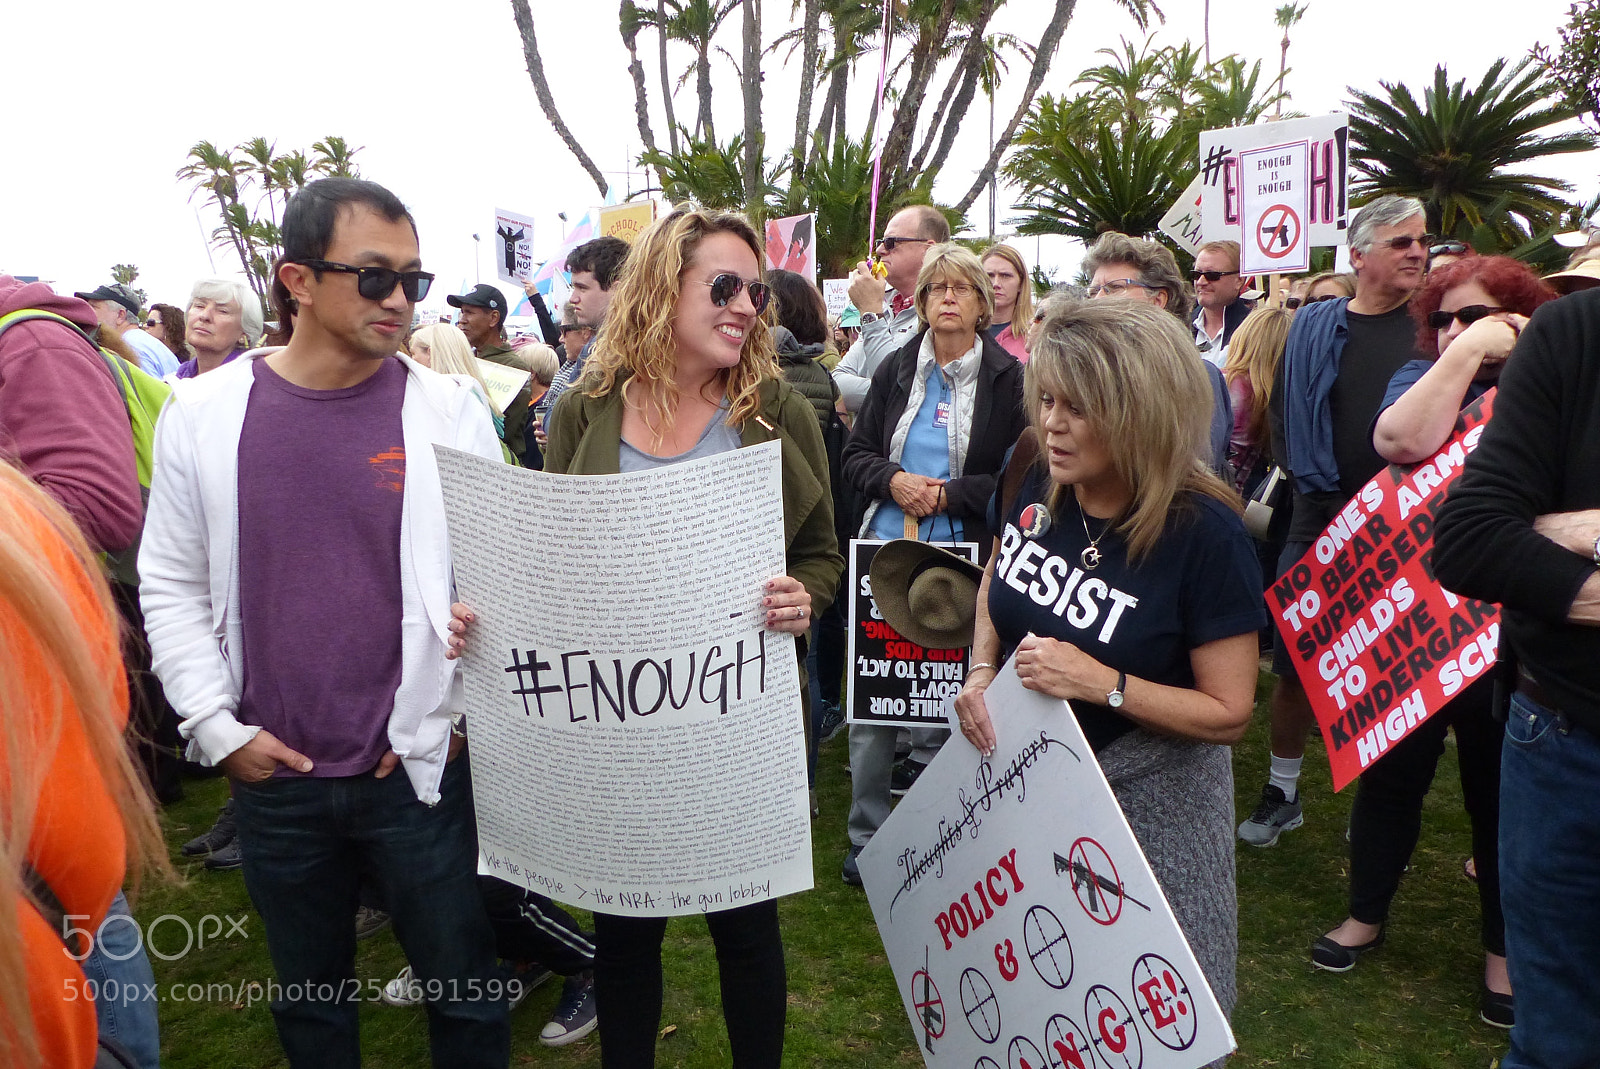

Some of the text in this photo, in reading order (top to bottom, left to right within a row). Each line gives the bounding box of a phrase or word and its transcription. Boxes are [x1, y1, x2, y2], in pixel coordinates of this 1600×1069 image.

[1257, 154, 1292, 171] ENOUGH
[1257, 180, 1292, 196] ENOUGH
[1270, 171, 1279, 181] IS
[516, 260, 531, 271] NO!
[518, 244, 530, 252] NO!
[1272, 480, 1383, 609] NO ONE'S
[1282, 590, 1321, 632] TO
[1320, 514, 1393, 596] BEAR
[1396, 424, 1485, 520] ARMS
[996, 522, 1139, 644] RESIST
[885, 641, 923, 659] KIDS
[1318, 577, 1415, 682] CHILD'S
[1327, 599, 1437, 710] TO LIVE
[505, 630, 766, 723] #ENOUGH
[856, 655, 963, 681] FAILS TO ACT,
[909, 680, 963, 699] GOV'T
[869, 697, 907, 716] OUR
[1356, 689, 1428, 768] HIGH
[897, 815, 963, 892] Thoughts
[976, 730, 1049, 811] Prayers
[483, 848, 501, 869] We
[503, 857, 521, 876] the
[525, 868, 566, 894] people
[591, 888, 613, 904] the
[667, 891, 691, 909] the
[698, 893, 723, 912] gun
[729, 880, 771, 903] lobby
[934, 848, 1025, 951] POLICY
[994, 938, 1019, 982] &
